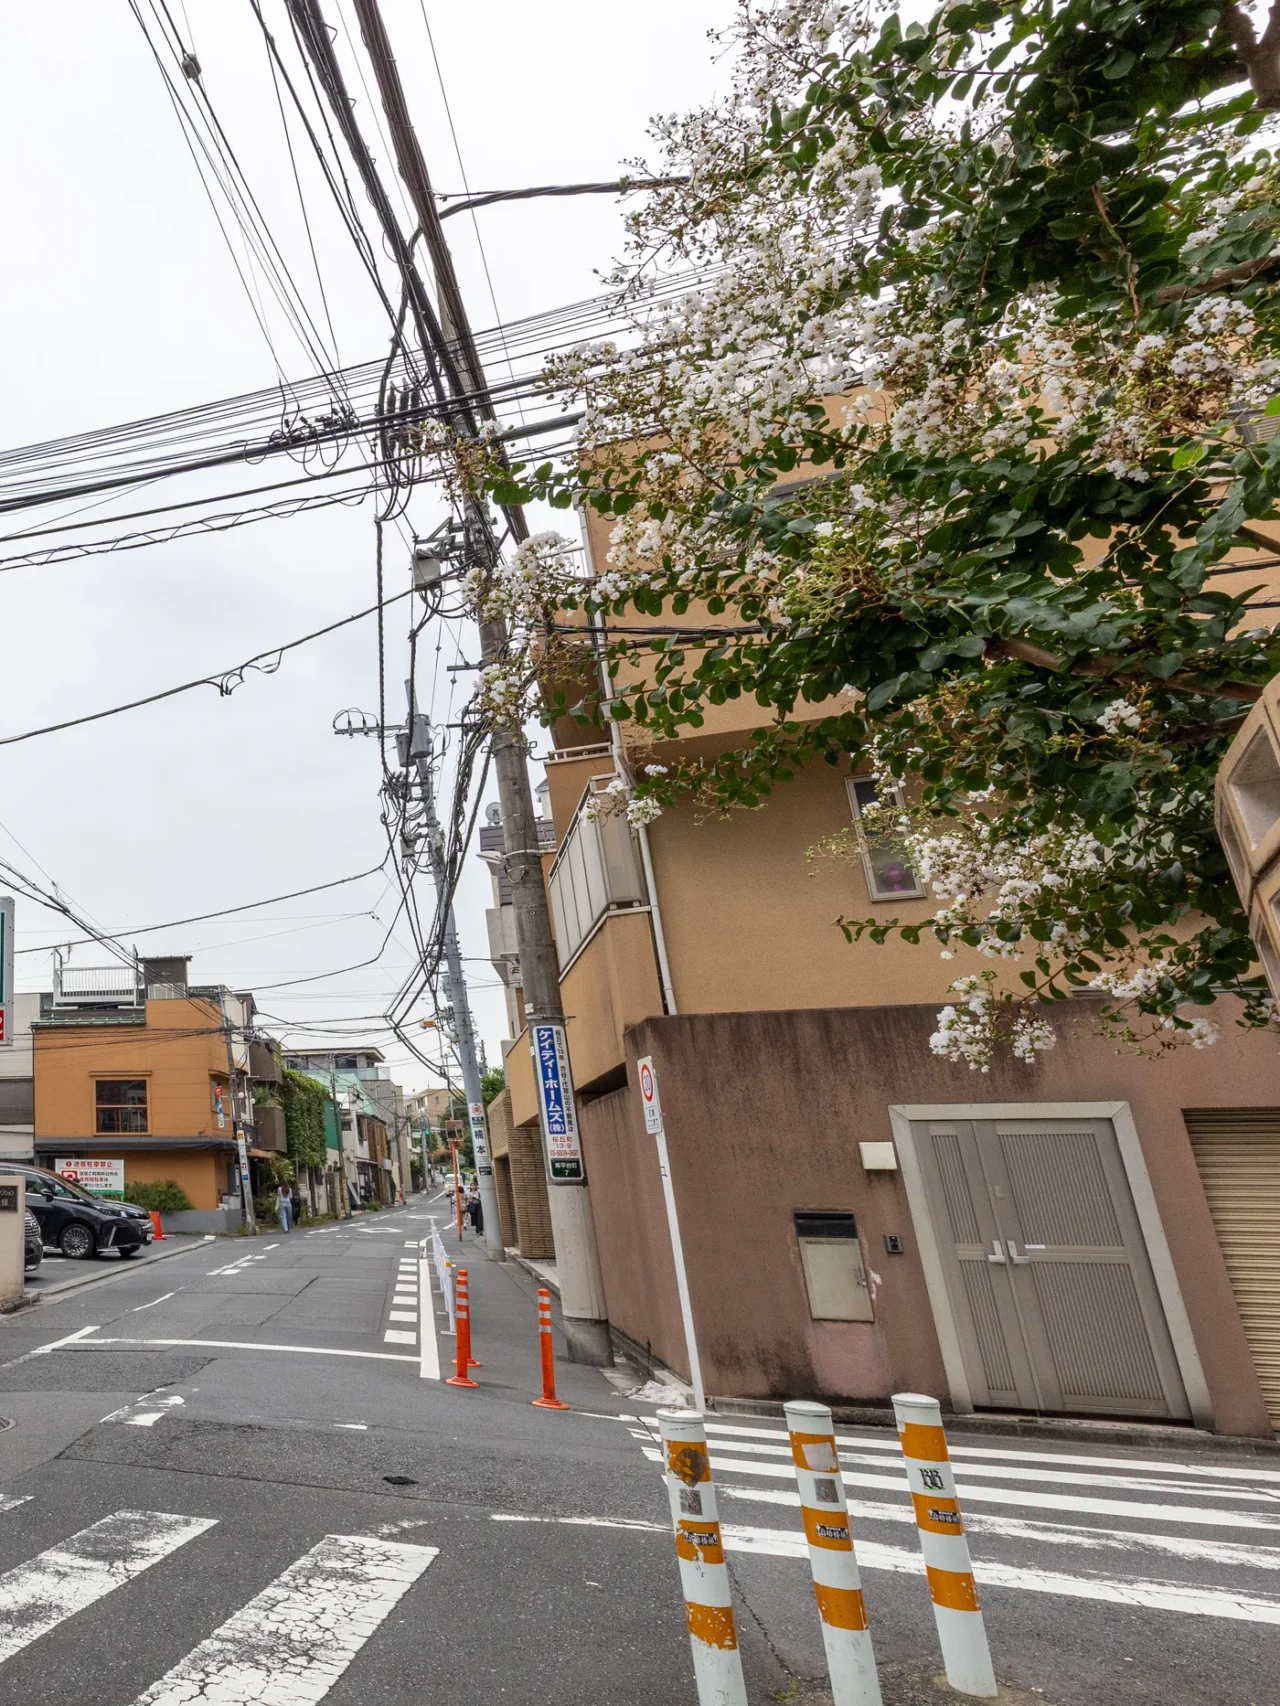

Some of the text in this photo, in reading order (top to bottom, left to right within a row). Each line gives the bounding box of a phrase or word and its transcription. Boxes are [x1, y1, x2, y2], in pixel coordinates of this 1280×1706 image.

[538, 1029, 565, 1133] ケイティーホームズ(株)
[73, 1160, 113, 1168] 迷惑駐車禁止
